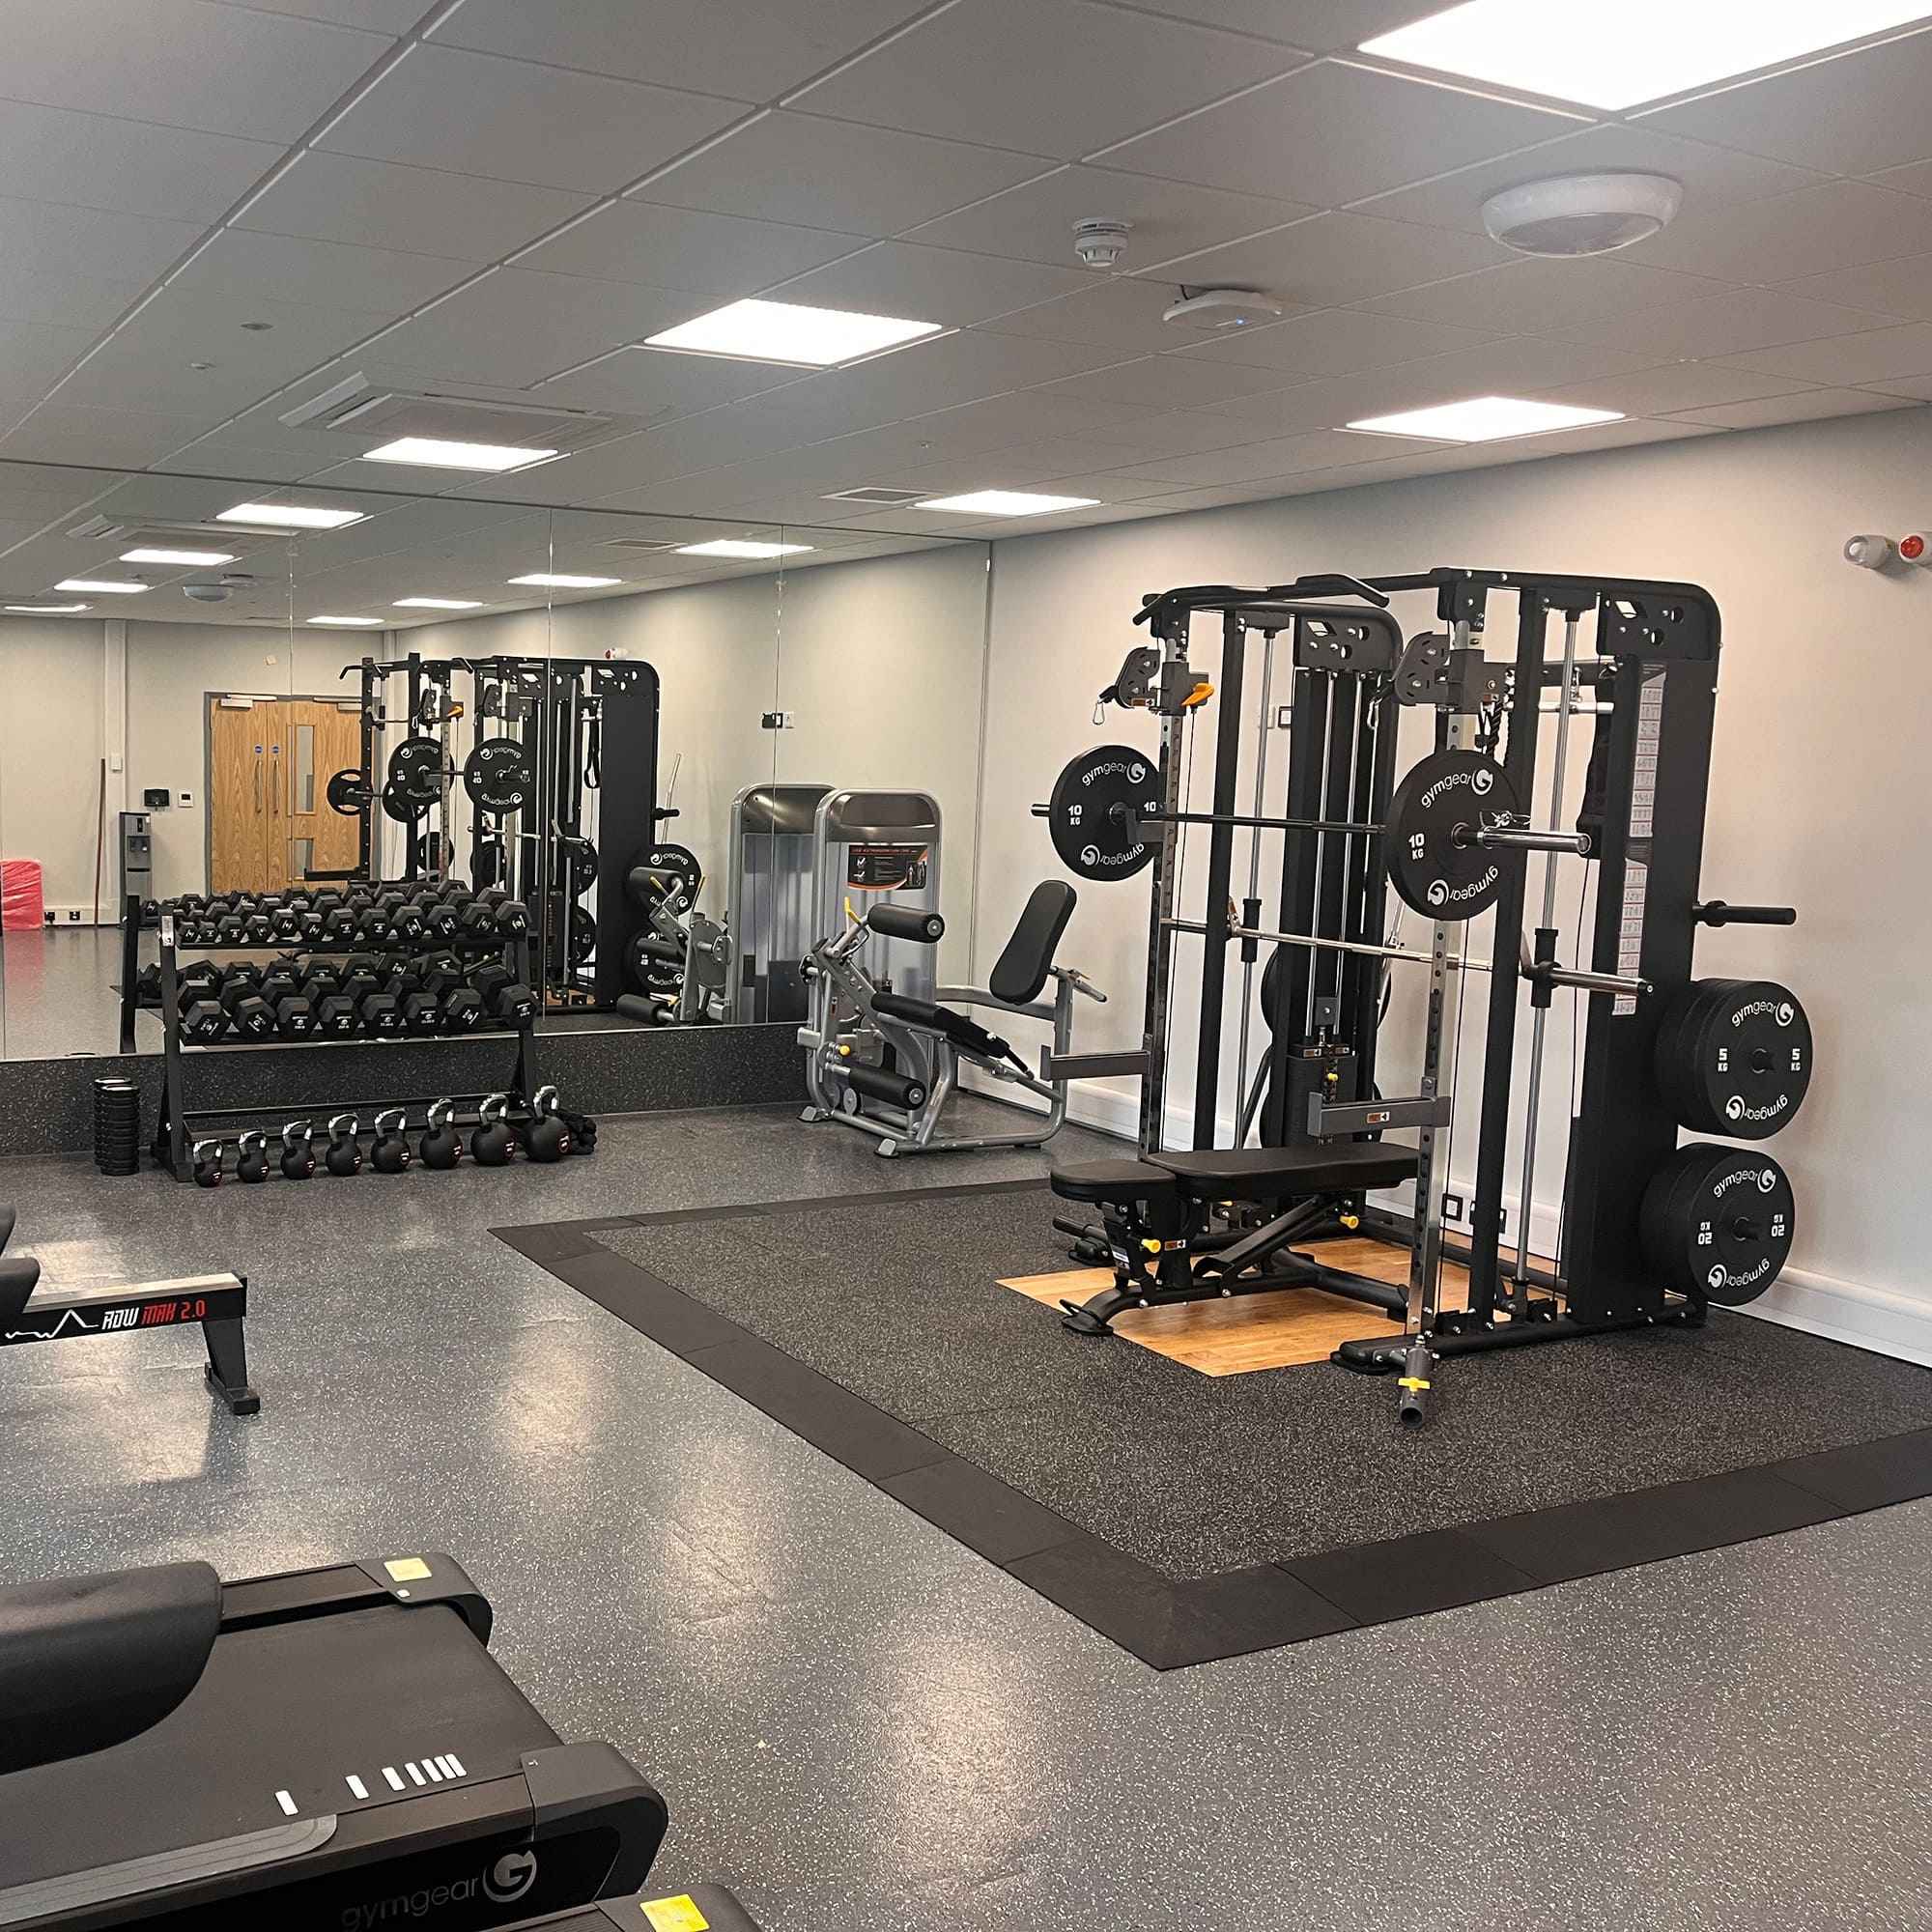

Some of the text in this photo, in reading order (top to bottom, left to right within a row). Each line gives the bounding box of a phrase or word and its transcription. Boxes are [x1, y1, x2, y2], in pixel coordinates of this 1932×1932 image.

[1081, 762, 1127, 786] gymgear
[1421, 772, 1472, 809] gymgear
[1067, 804, 1083, 816] 10
[1144, 802, 1157, 812] 10
[1408, 833, 1426, 849] 10
[1099, 841, 1145, 866] gymgear
[1411, 848, 1425, 861] KG
[1449, 865, 1499, 901] gymgear
[1731, 1001, 1777, 1027] gymgear
[1718, 1047, 1728, 1061] 5
[1791, 1047, 1801, 1061] 5
[1718, 1063, 1729, 1072] KG
[1790, 1063, 1802, 1072] KG
[1744, 1094, 1789, 1121] gymgear
[1713, 1170, 1758, 1198] gymgear
[1697, 1232, 1713, 1245] 20
[1771, 1225, 1785, 1237] 20
[1725, 1258, 1771, 1287] gymgear
[101, 1299, 206, 1330] ROW MAX 2.0
[341, 1876, 479, 1932] gymgear
